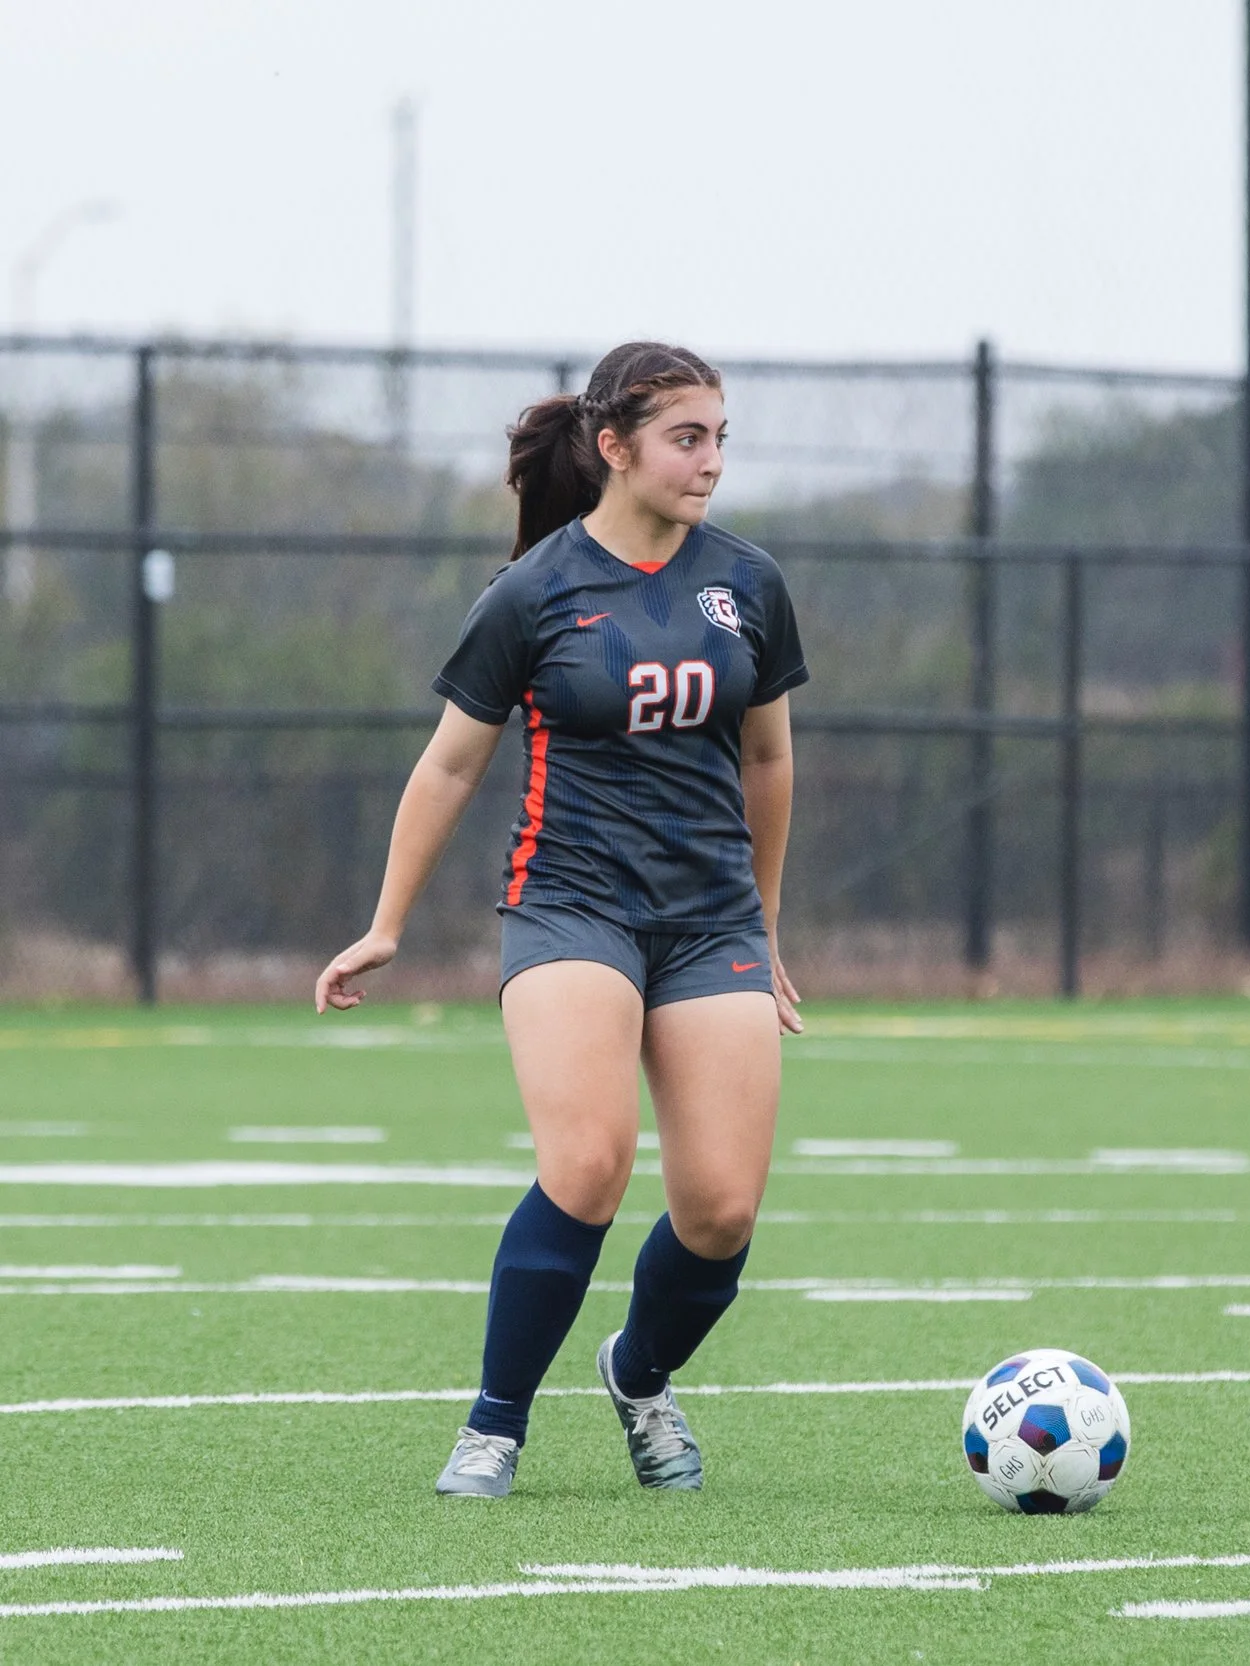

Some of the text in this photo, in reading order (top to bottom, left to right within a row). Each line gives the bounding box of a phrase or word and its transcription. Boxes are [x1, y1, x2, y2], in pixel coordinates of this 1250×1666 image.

[628, 660, 716, 735] 20
[982, 1366, 1067, 1430] SELECT
[1081, 1405, 1105, 1427] GHS
[1000, 1455, 1025, 1480] GHS
